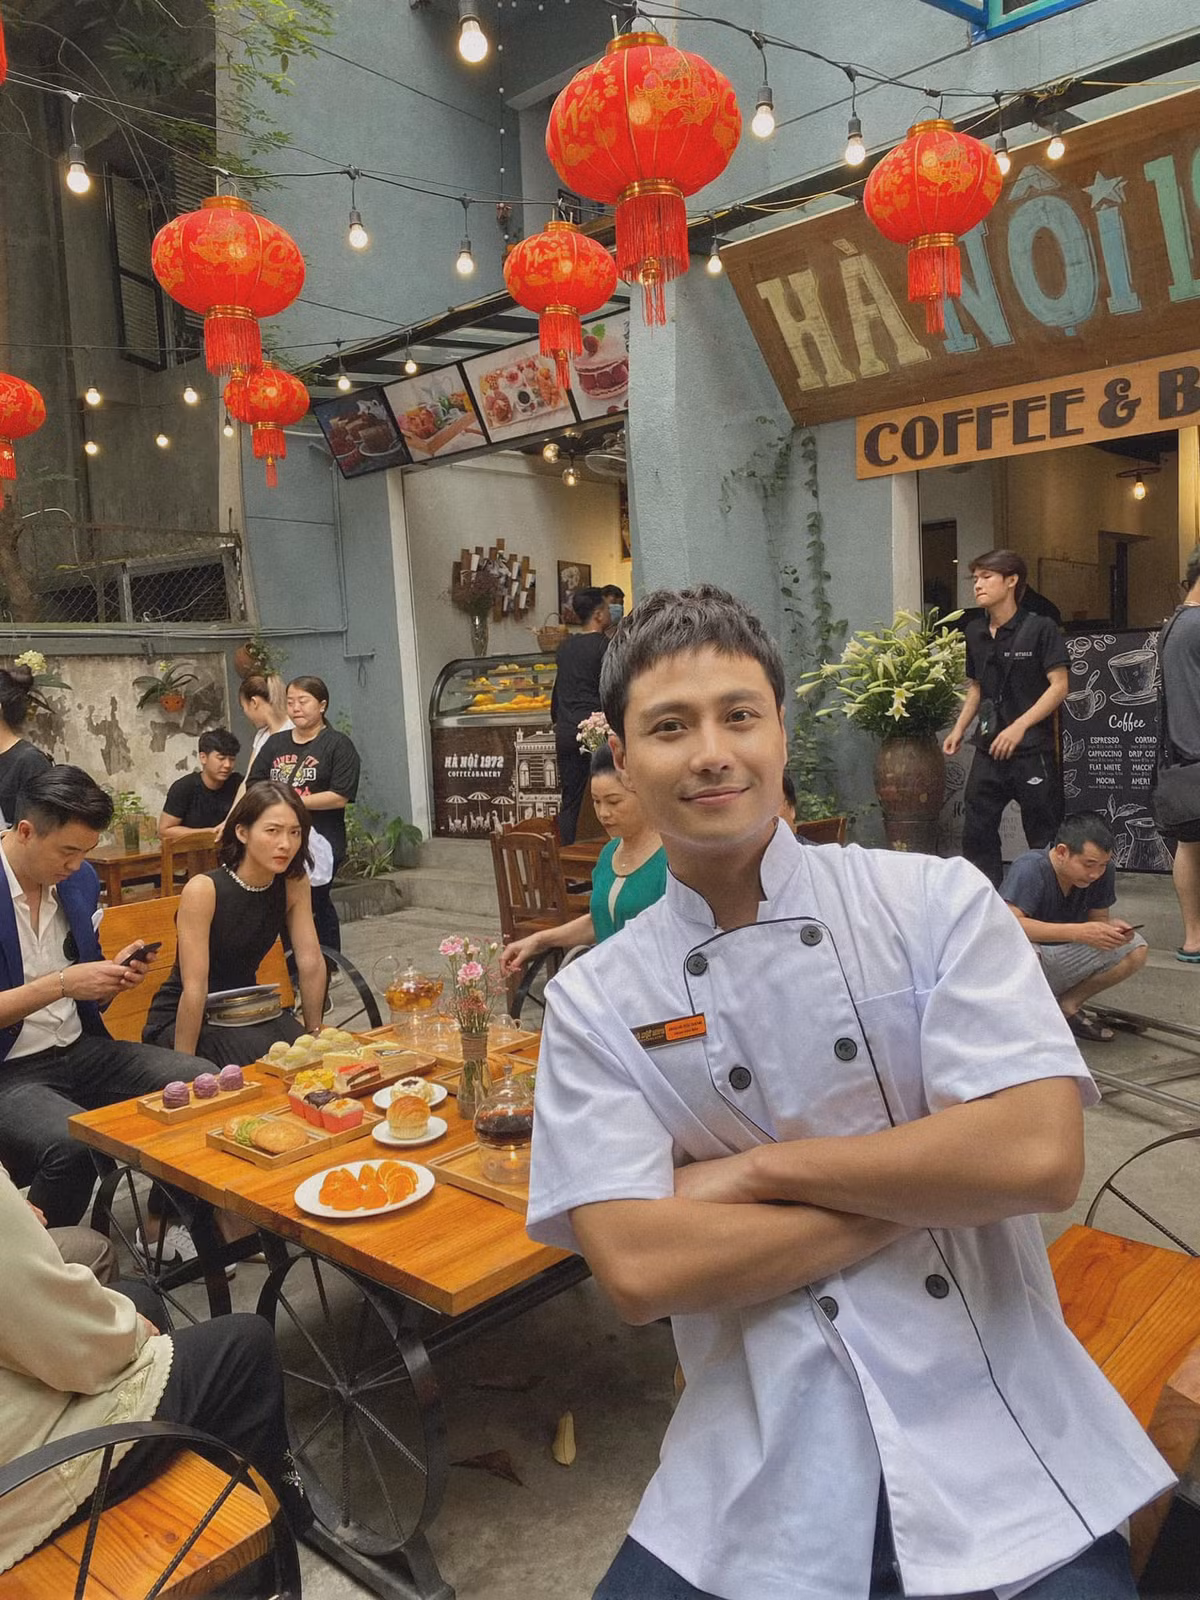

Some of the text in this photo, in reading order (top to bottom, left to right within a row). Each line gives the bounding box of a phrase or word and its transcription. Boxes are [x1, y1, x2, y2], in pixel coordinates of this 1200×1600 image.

[756, 239, 931, 391] HÀ
[1143, 146, 1200, 303] 1
[863, 387, 1085, 467] COFFEE
[1098, 378, 1142, 428] &
[1108, 712, 1146, 732] Coffee
[480, 755, 504, 768] 1972
[1096, 777, 1116, 785] MOCHA
